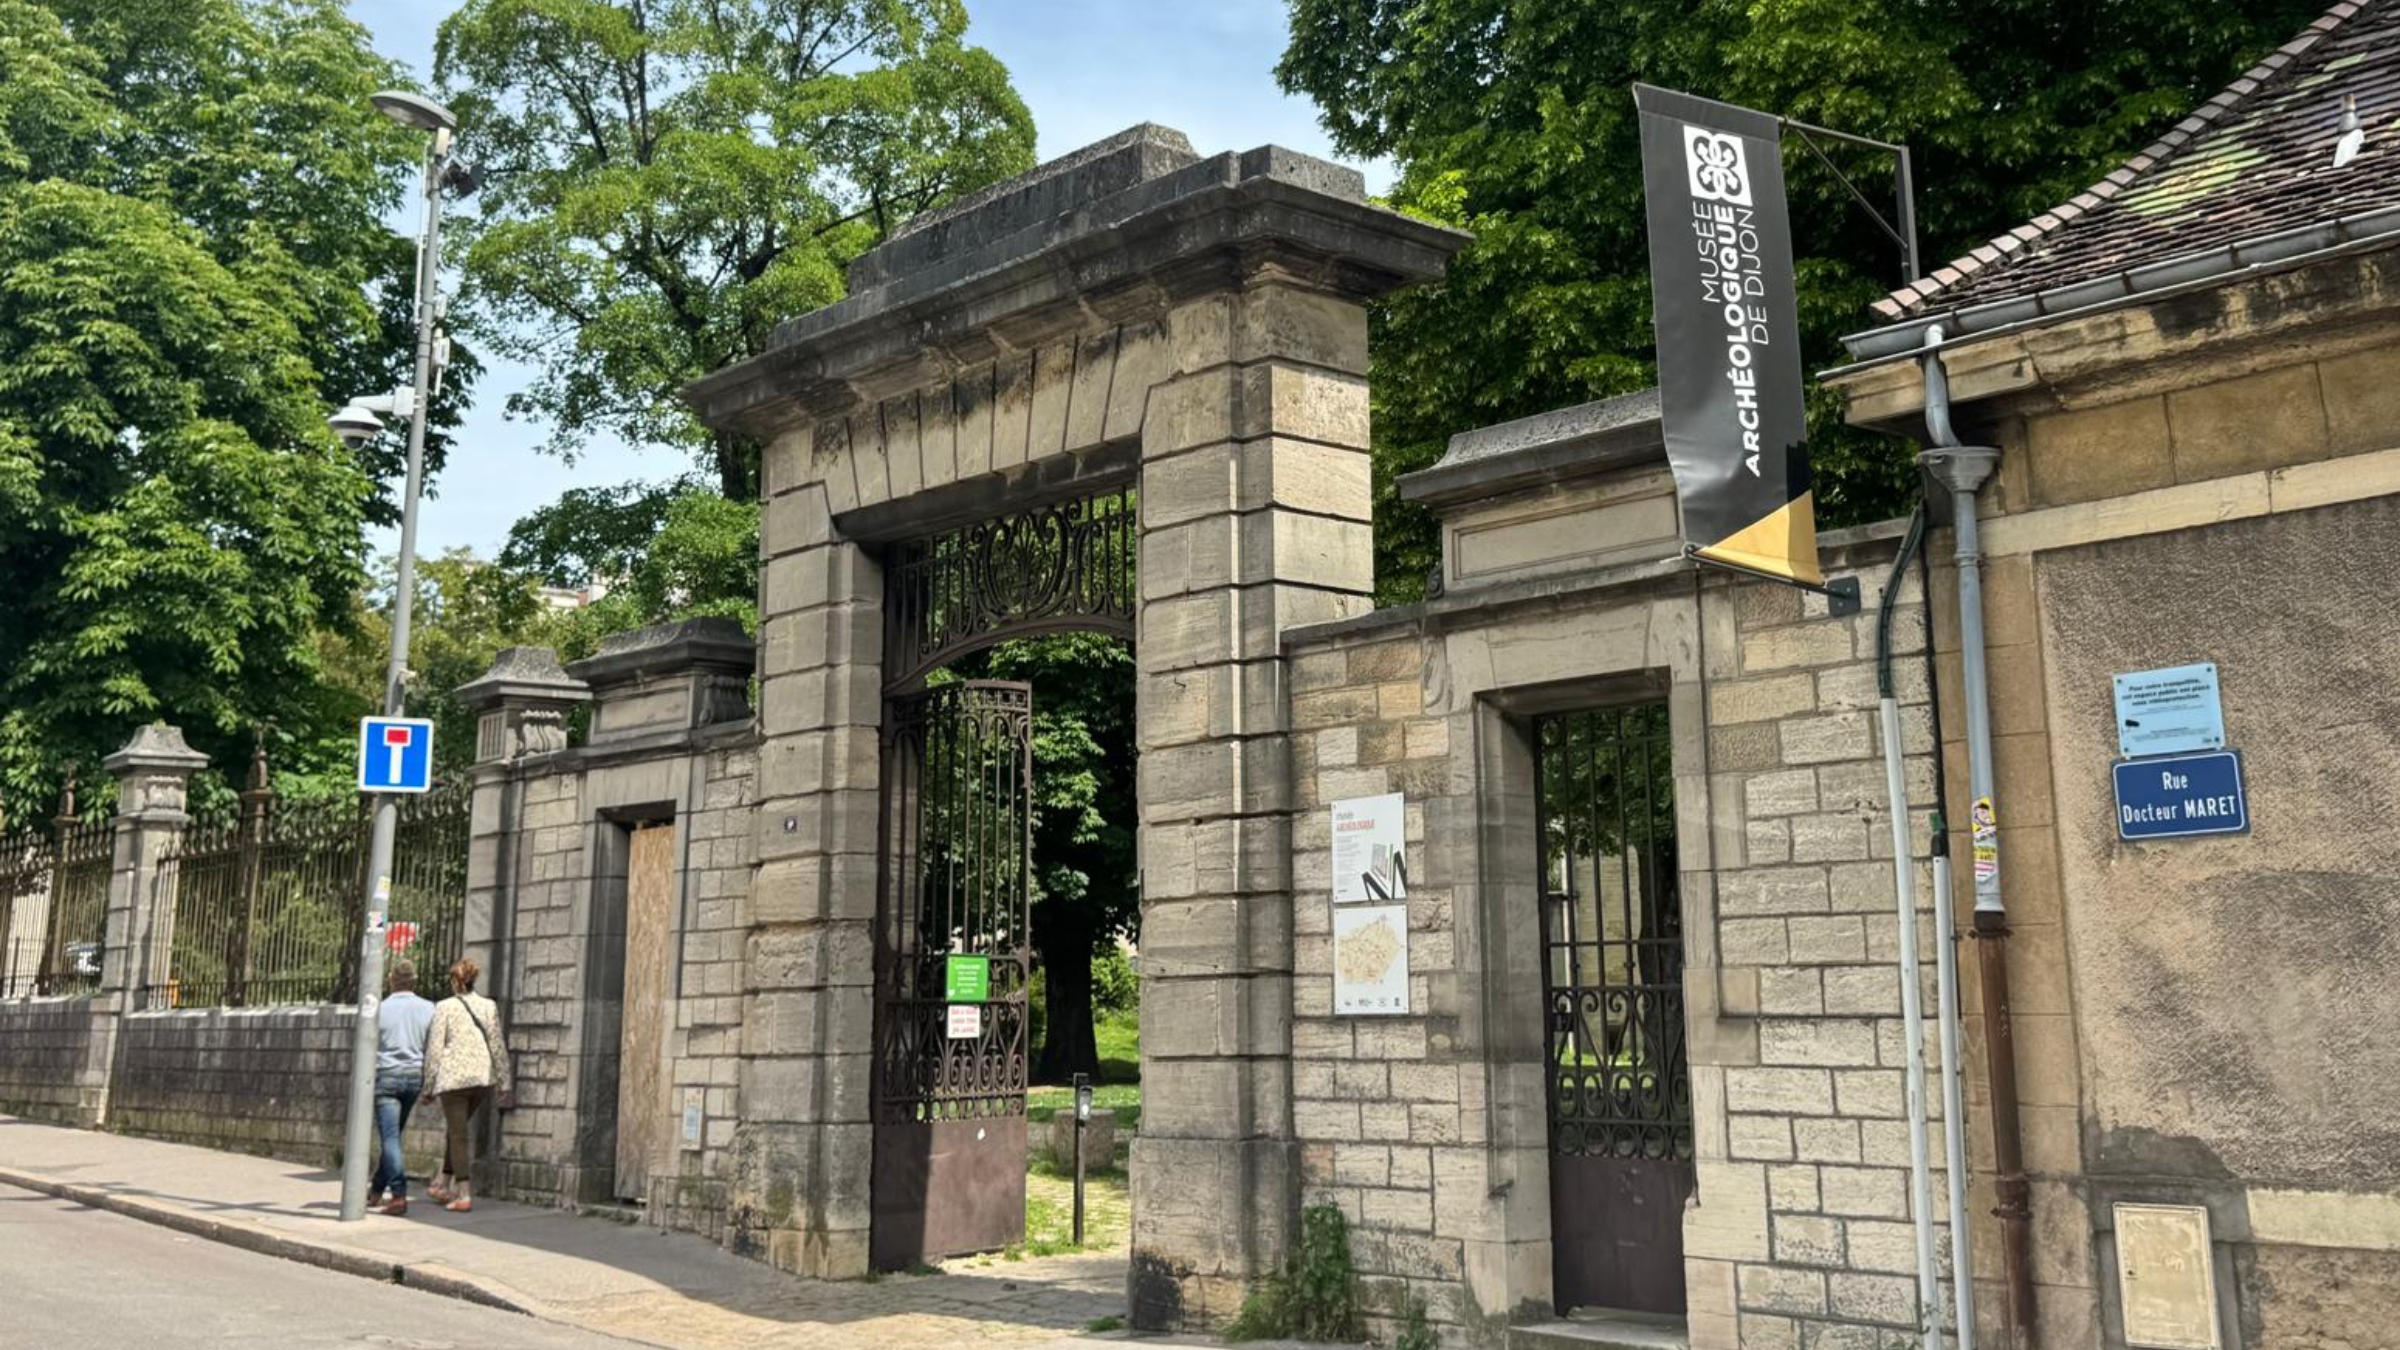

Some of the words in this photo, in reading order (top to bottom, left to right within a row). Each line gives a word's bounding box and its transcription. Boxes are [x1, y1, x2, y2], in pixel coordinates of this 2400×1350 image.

[1691, 200, 1721, 303] MUSÉE
[1736, 207, 1764, 296] DIJON
[1713, 204, 1761, 478] ARCHÉOLOGIQUE
[1747, 304, 1769, 345] DE
[2122, 803, 2178, 823] Docteur
[2184, 795, 2235, 819] MARET
[2162, 771, 2188, 790] Rue
